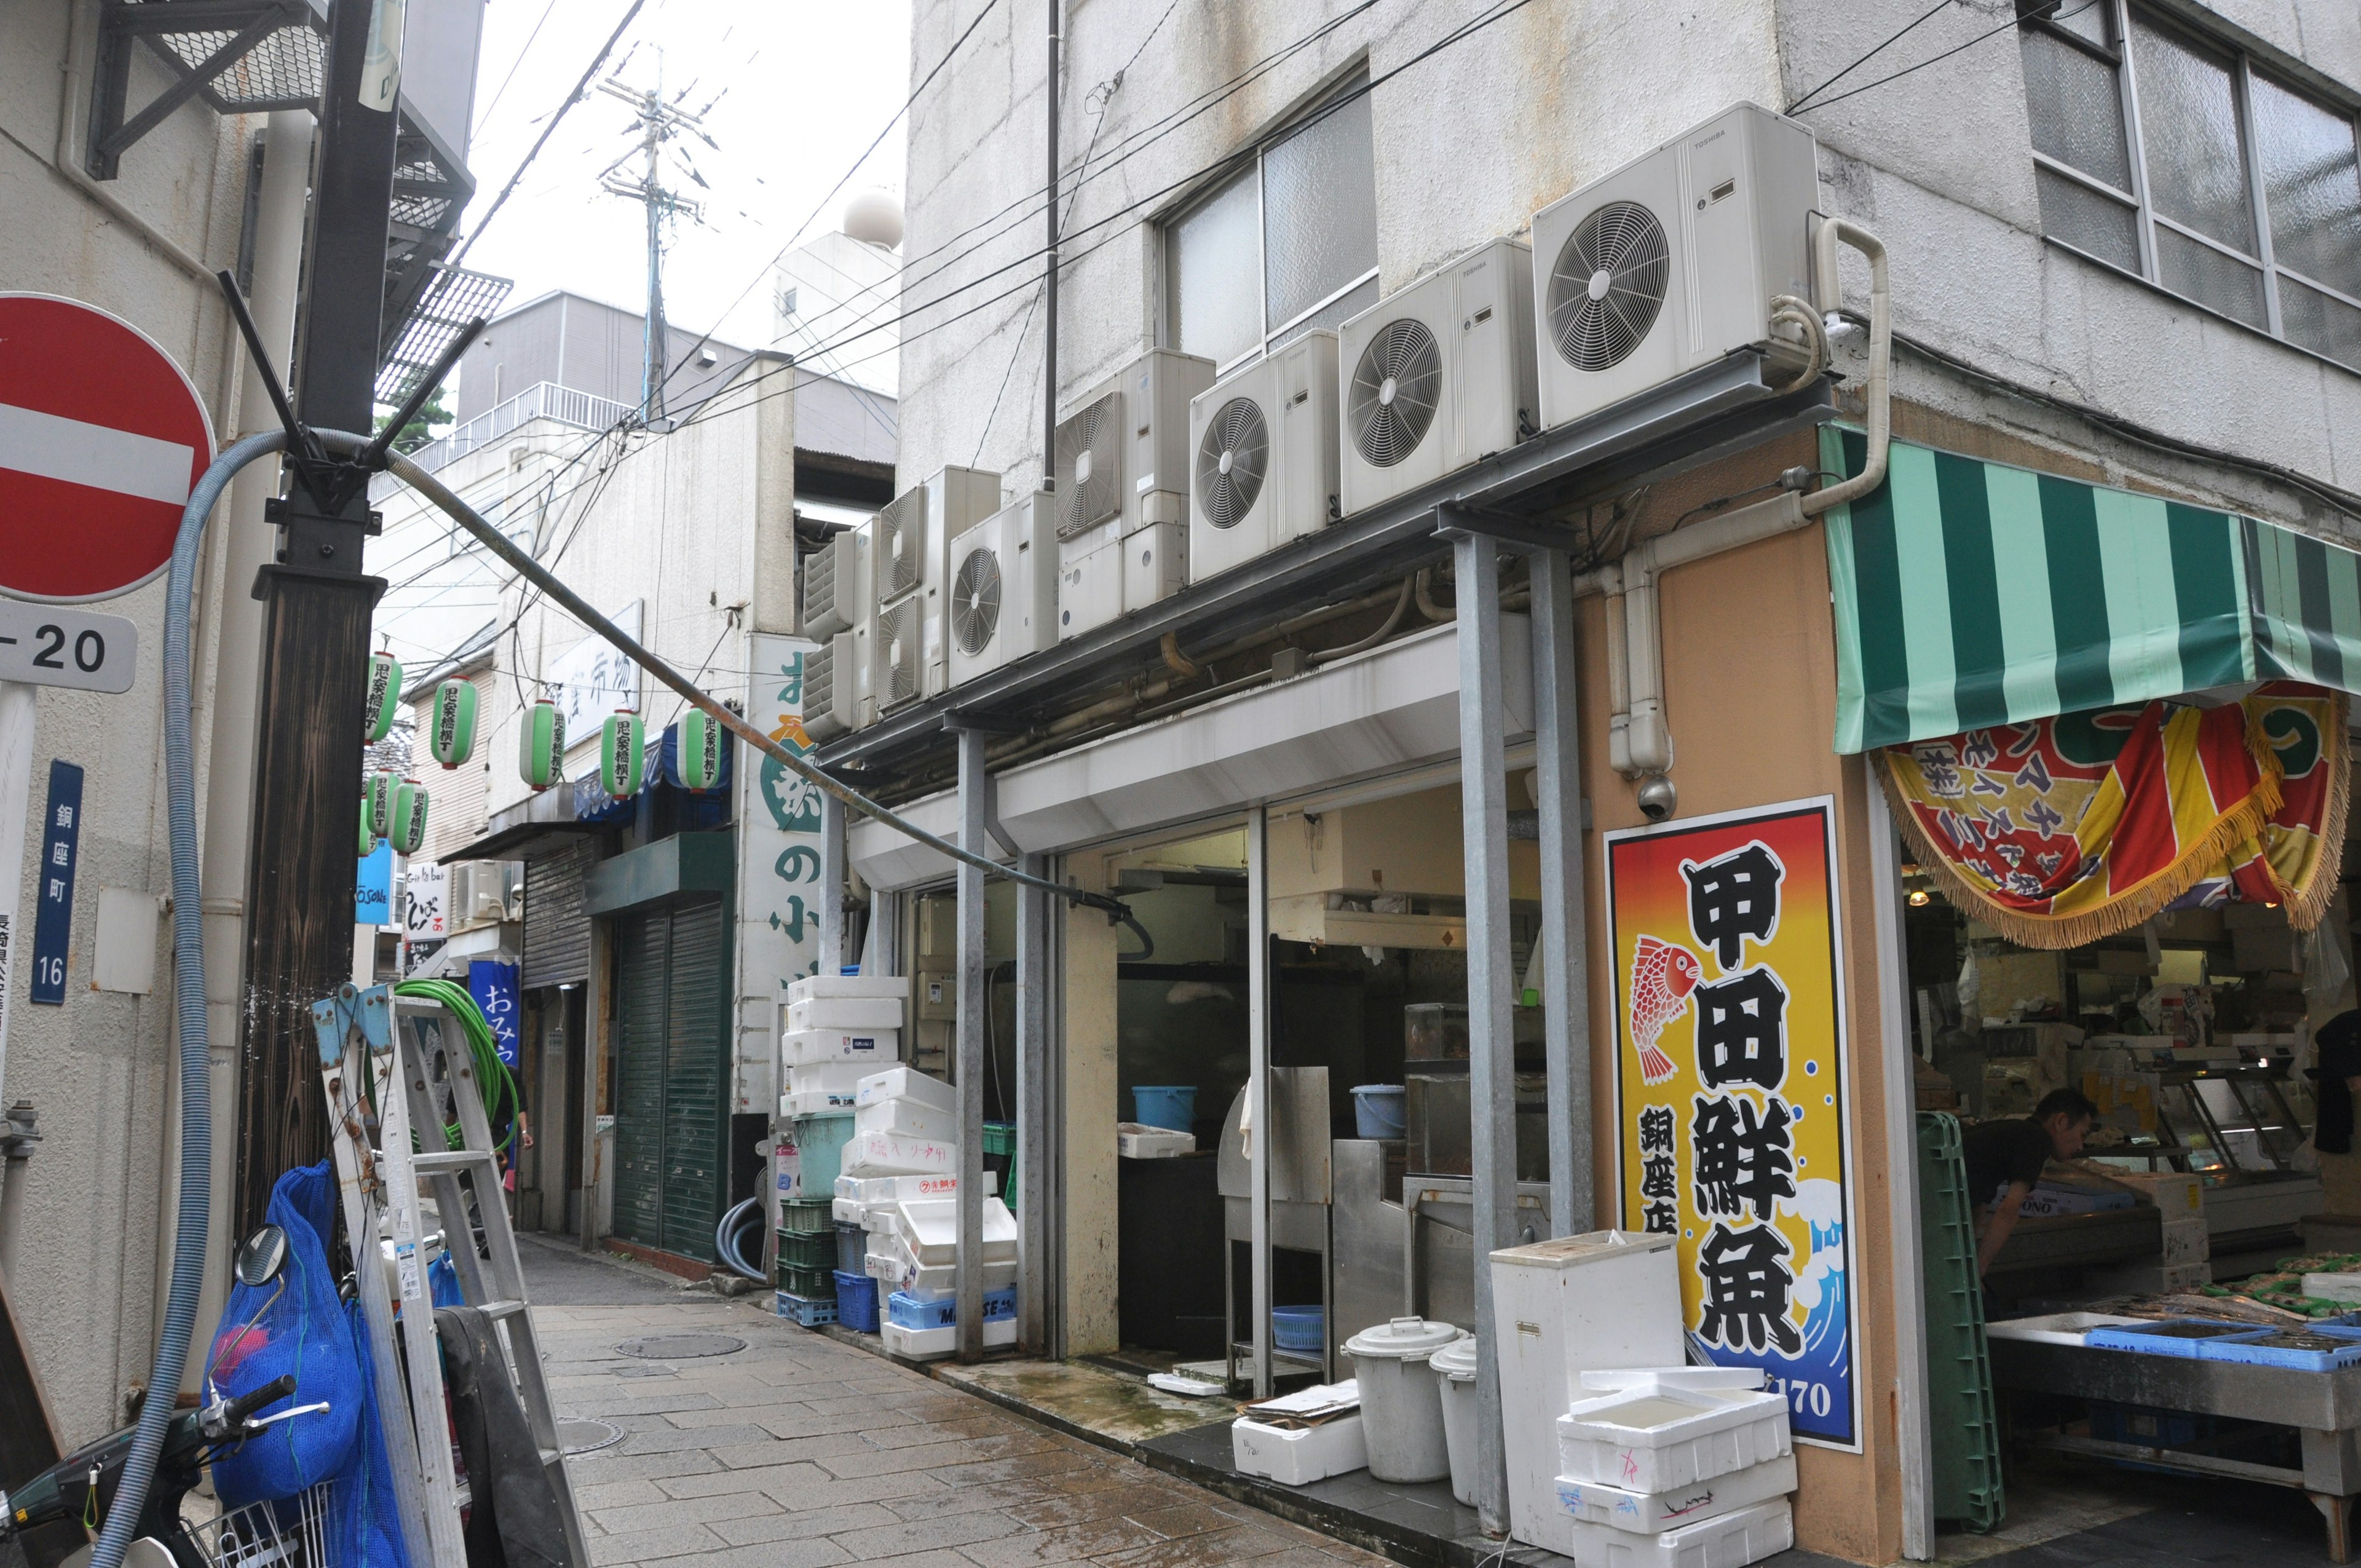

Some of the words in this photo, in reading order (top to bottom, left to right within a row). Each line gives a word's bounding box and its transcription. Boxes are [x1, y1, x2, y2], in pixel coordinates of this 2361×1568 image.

[1695, 130, 1725, 149] TOSHIBA
[1463, 261, 1487, 277] TOSHIBA
[365, 664, 390, 729] 思案橋横丁
[439, 687, 458, 751] 思案橋横丁
[551, 713, 564, 777] 思案橋横丁
[615, 721, 630, 786] 思案橋横丁
[703, 718, 716, 780] 思案橋横丁
[375, 778, 387, 826] 思案橋横丁
[408, 793, 424, 845] 思案橋横丁
[49, 804, 73, 903] 銅座町
[408, 867, 429, 883] Girl's
[431, 867, 445, 881] bar
[40, 956, 63, 985] 16
[1680, 841, 1804, 1357] 甲田鮮魚
